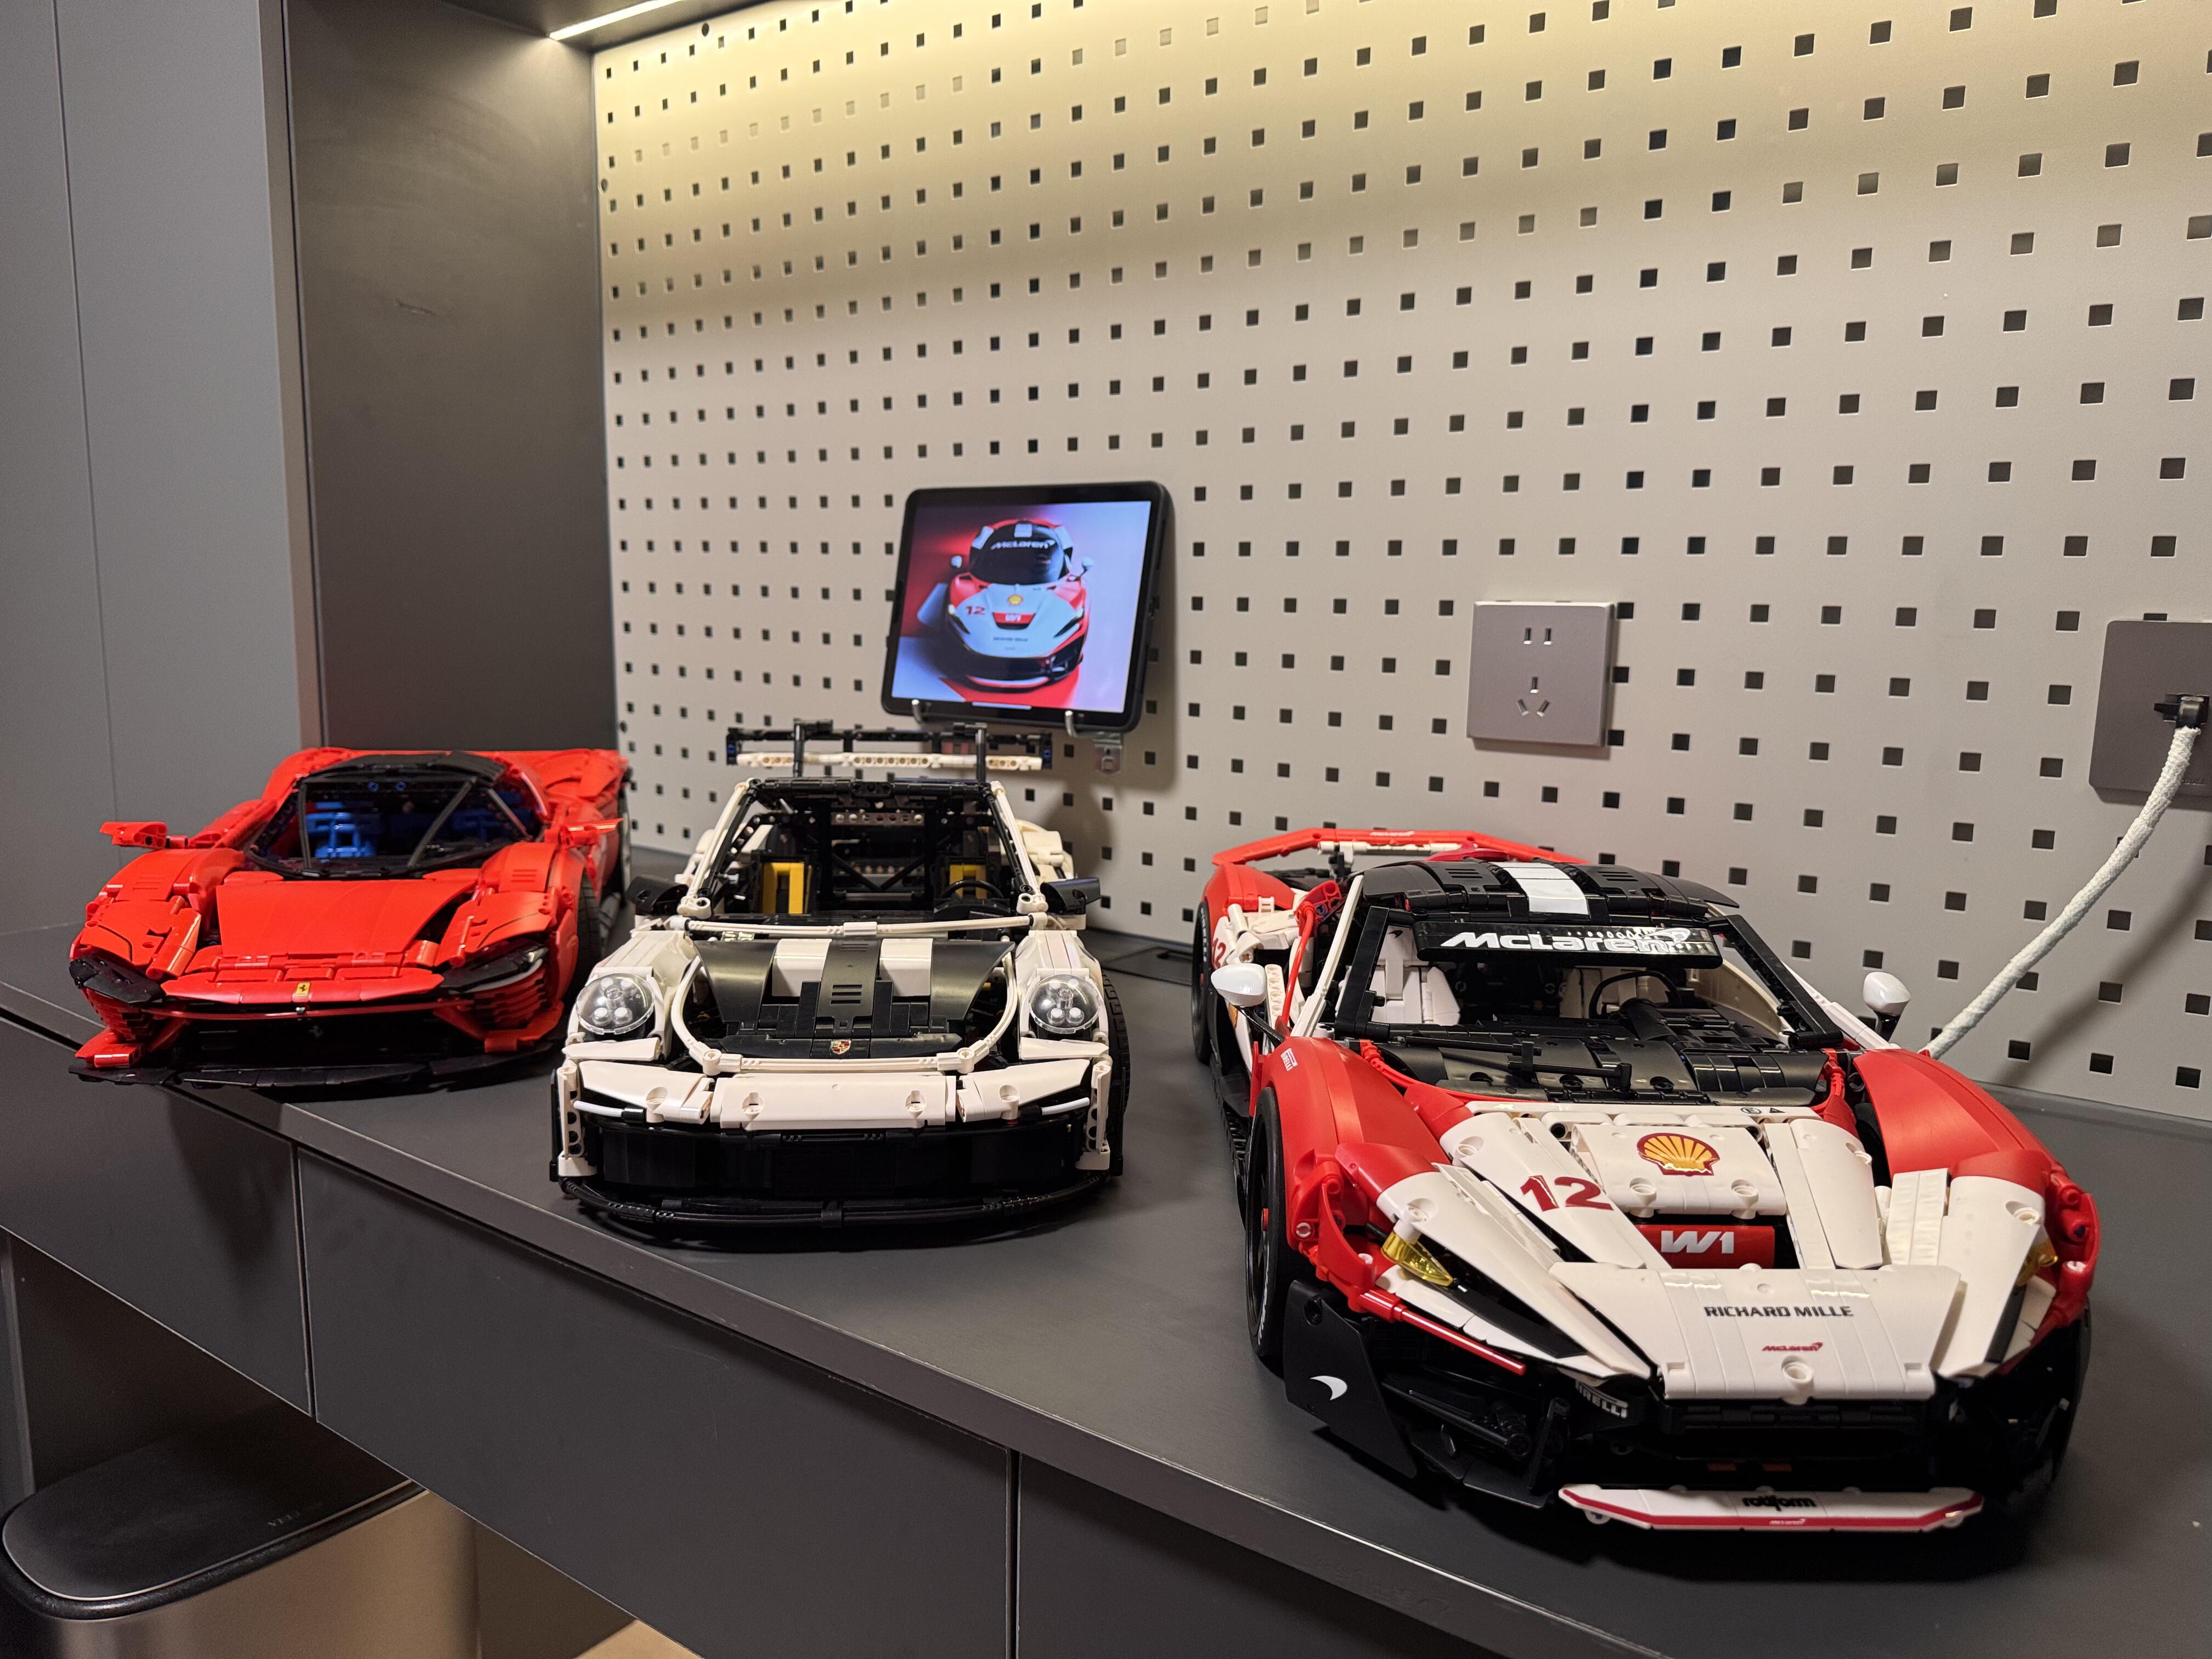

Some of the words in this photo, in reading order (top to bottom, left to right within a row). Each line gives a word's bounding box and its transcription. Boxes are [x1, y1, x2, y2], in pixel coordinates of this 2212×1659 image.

[966, 605, 985, 616] 12
[1441, 928, 1690, 953] McLaren
[1520, 1175, 1614, 1211] 12
[1661, 1230, 1735, 1254] W1
[1704, 1306, 1791, 1317] RICHARD
[1795, 1306, 1854, 1317] MILLE
[1761, 1342, 1824, 1352] McLaren
